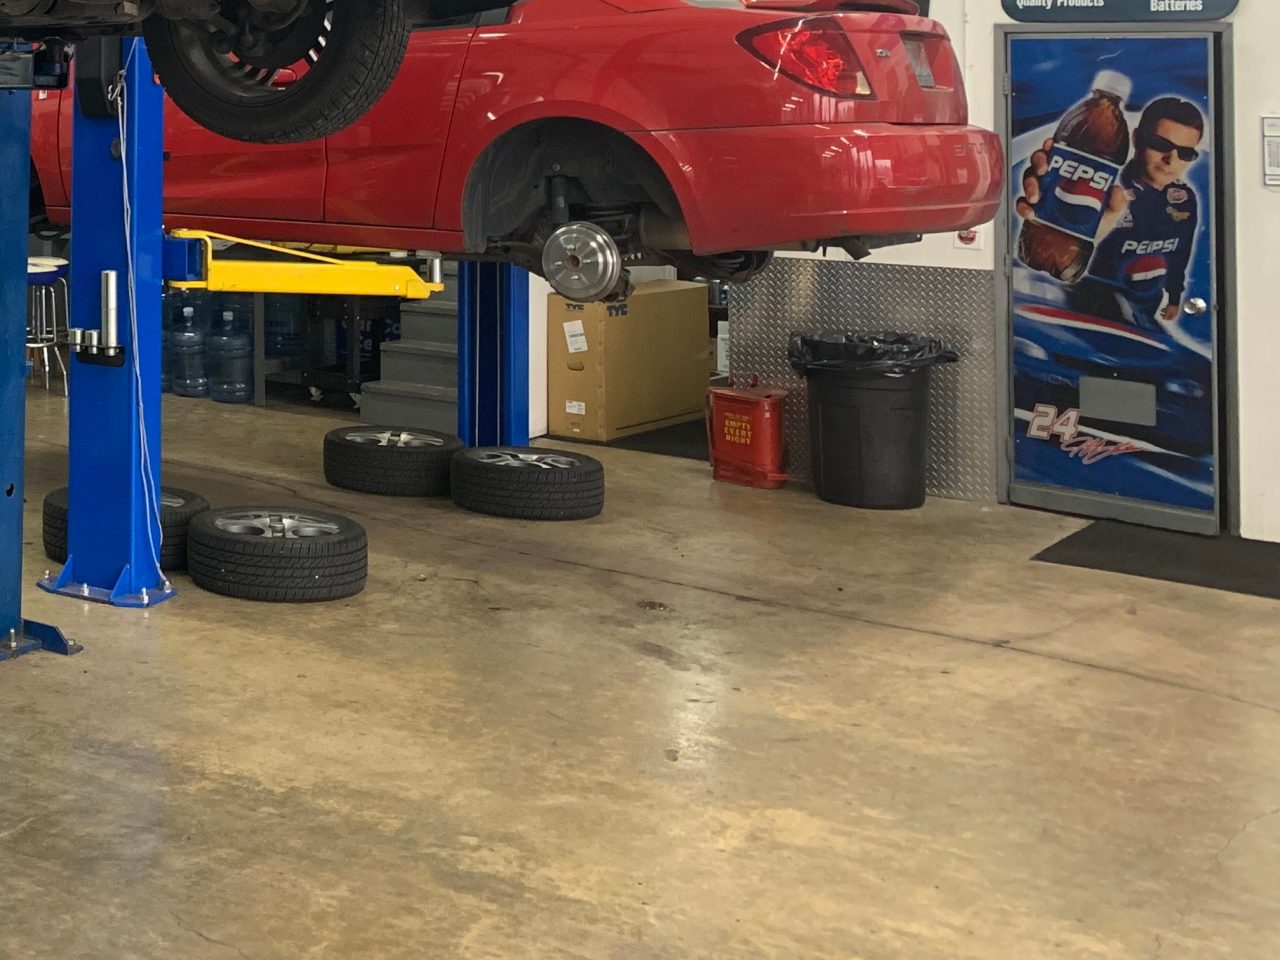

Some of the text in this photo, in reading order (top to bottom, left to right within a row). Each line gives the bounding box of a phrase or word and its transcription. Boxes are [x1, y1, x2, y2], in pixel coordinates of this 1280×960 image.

[1048, 155, 1114, 192] PEPSI
[1121, 237, 1179, 255] PEPSI
[607, 303, 628, 317] TYC
[724, 419, 751, 430] EMPTY
[1026, 403, 1080, 444] 24
[725, 434, 751, 445] NIGHT
